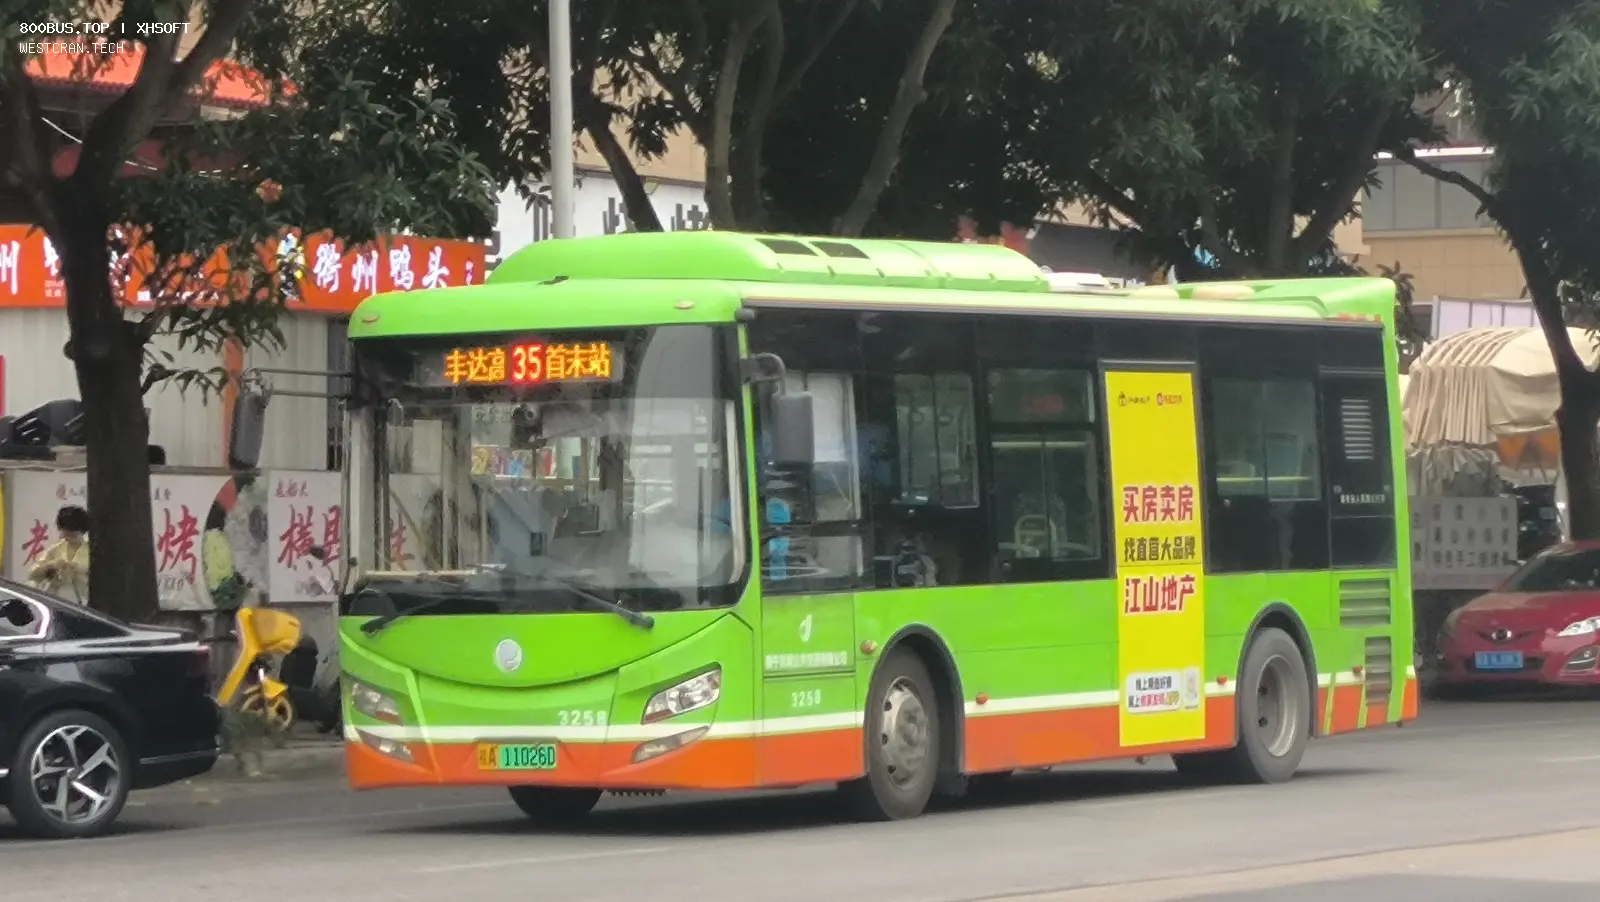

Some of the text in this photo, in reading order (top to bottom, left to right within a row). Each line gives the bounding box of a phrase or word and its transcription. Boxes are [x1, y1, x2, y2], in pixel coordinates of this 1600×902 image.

[512, 344, 542, 381] 35
[545, 341, 612, 380] 首末站
[1122, 485, 1194, 522] 买房卖房
[1124, 535, 1196, 562] 找直营大品牌
[1124, 574, 1196, 614] 江山地产
[558, 709, 608, 726] 3258
[504, 745, 556, 767] 11026D
